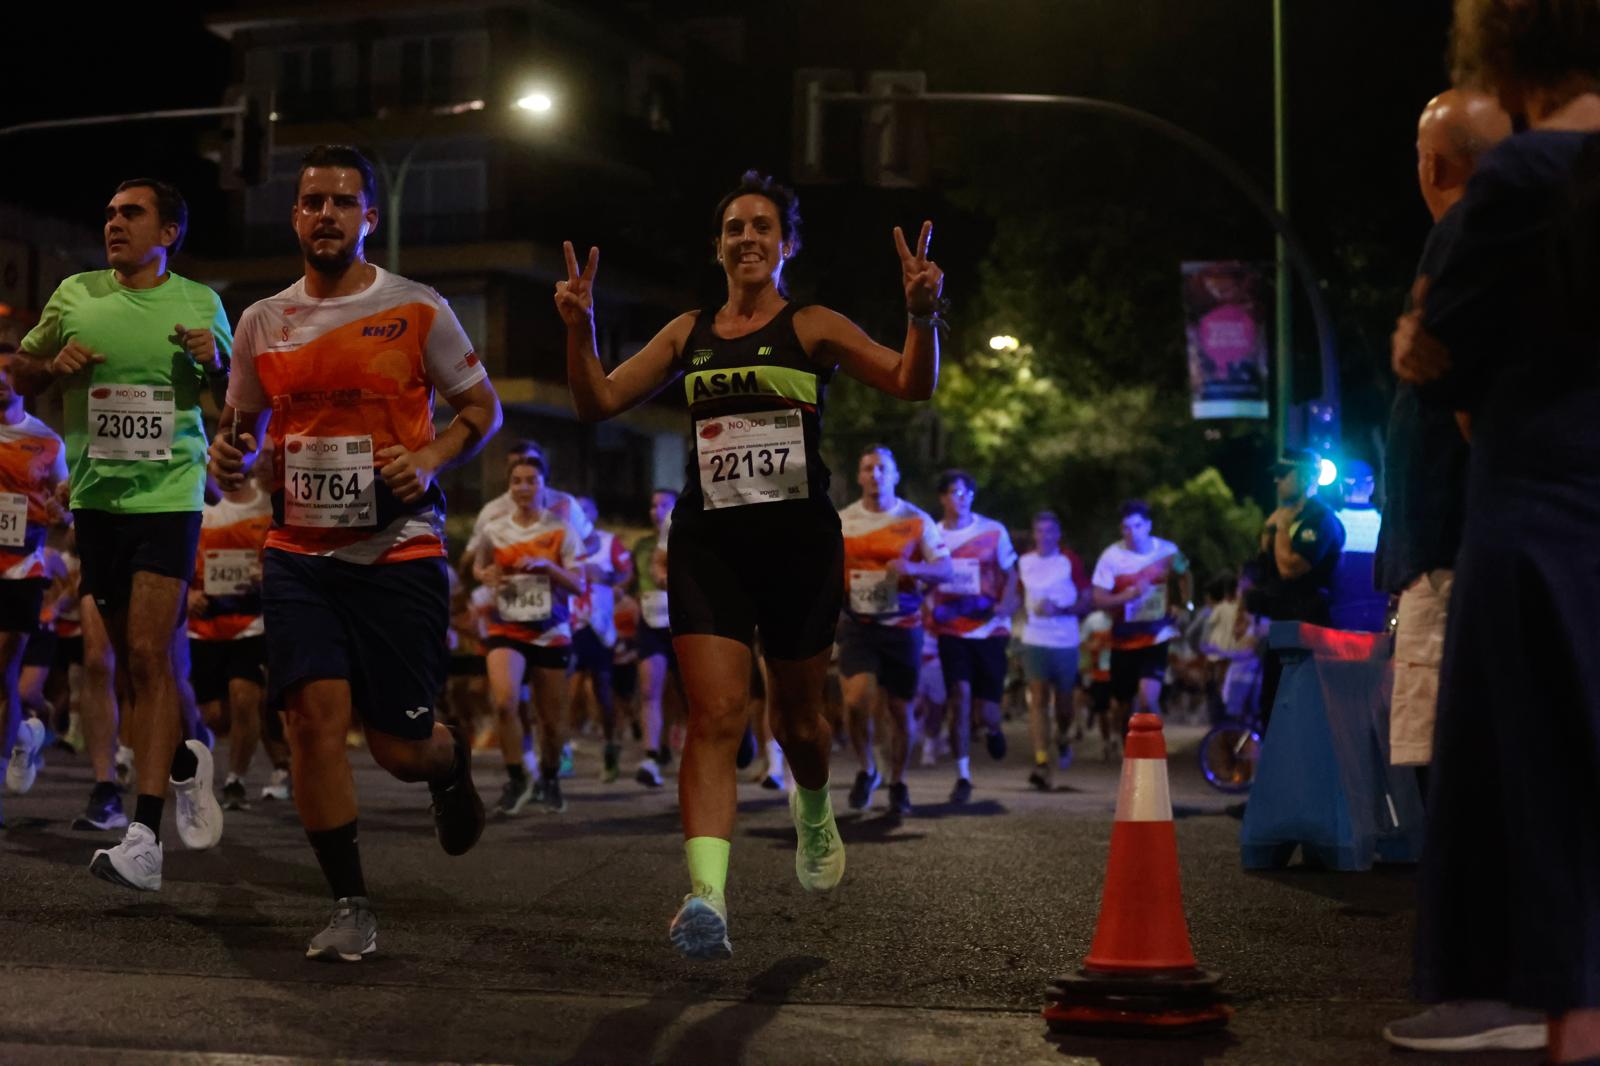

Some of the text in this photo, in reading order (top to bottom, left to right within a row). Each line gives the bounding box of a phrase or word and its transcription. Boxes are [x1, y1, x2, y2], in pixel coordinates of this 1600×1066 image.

[694, 371, 760, 401] ASM
[97, 414, 162, 439] 23035
[710, 448, 790, 483] 22137
[292, 472, 361, 501] 13764
